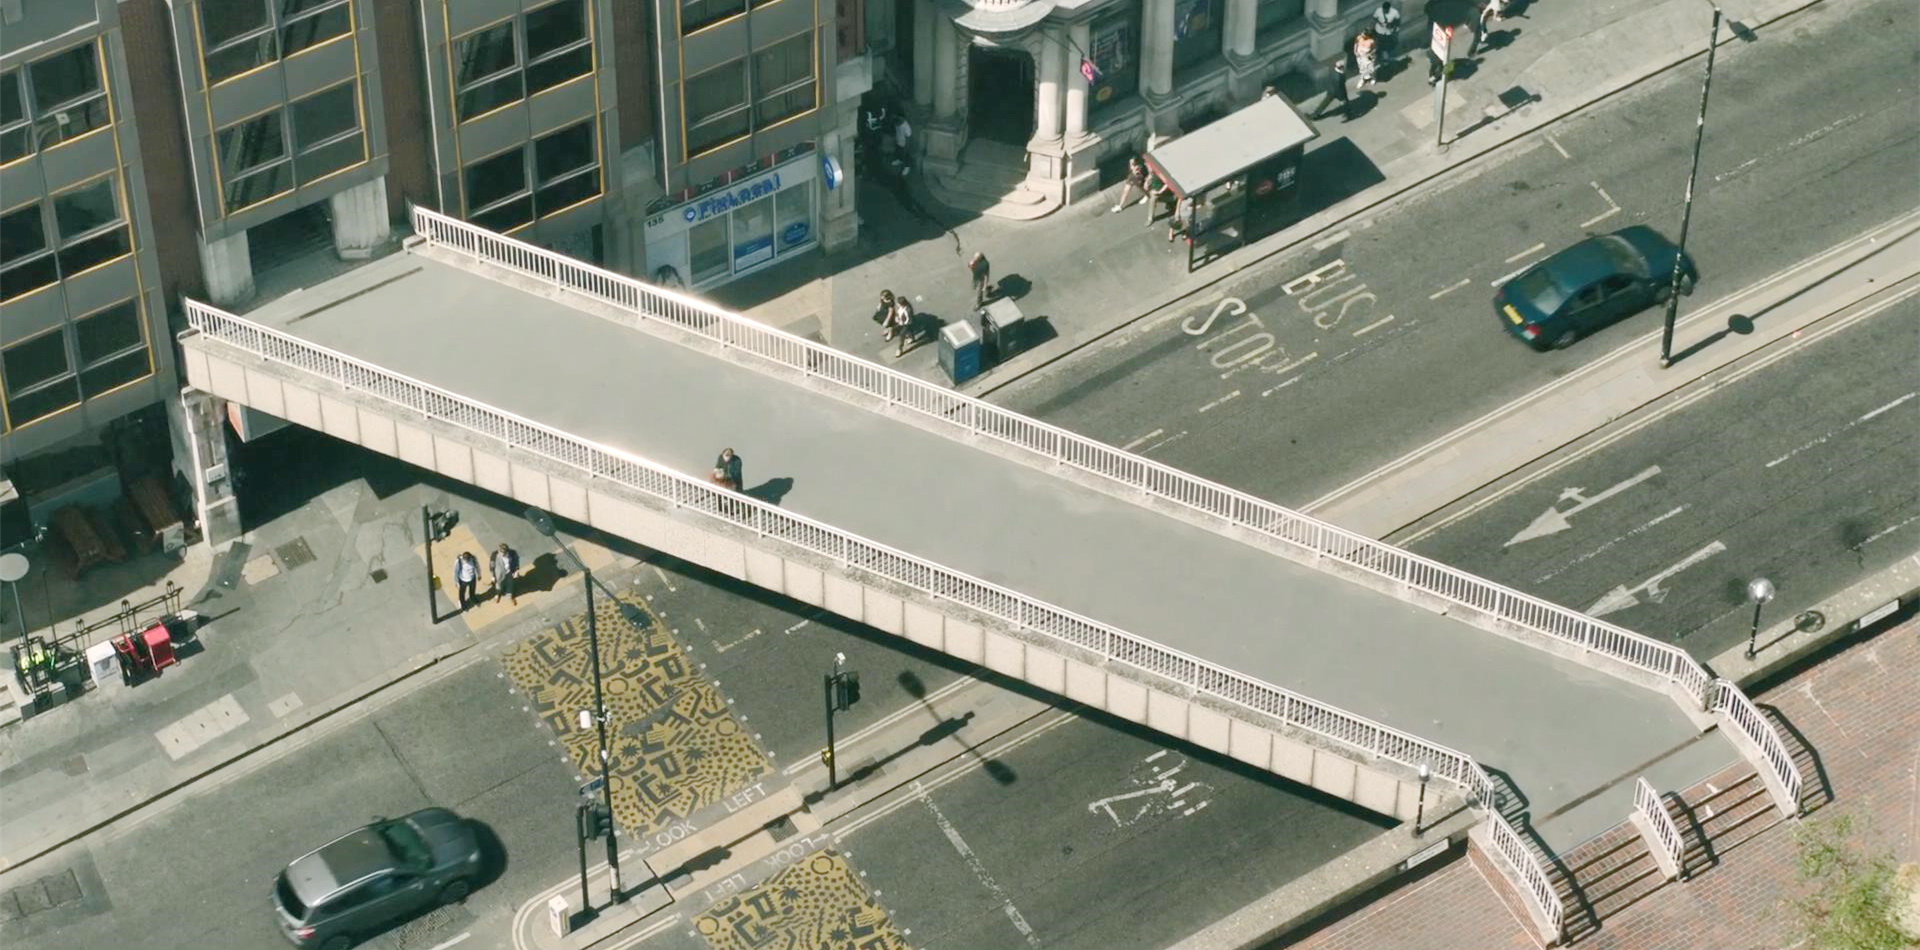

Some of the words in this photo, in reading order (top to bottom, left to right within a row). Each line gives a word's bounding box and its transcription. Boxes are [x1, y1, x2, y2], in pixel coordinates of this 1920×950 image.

[1281, 258, 1377, 330] BUS
[1181, 297, 1290, 379] STOP
[723, 782, 766, 813] LEFT
[764, 837, 815, 870] LOOK
